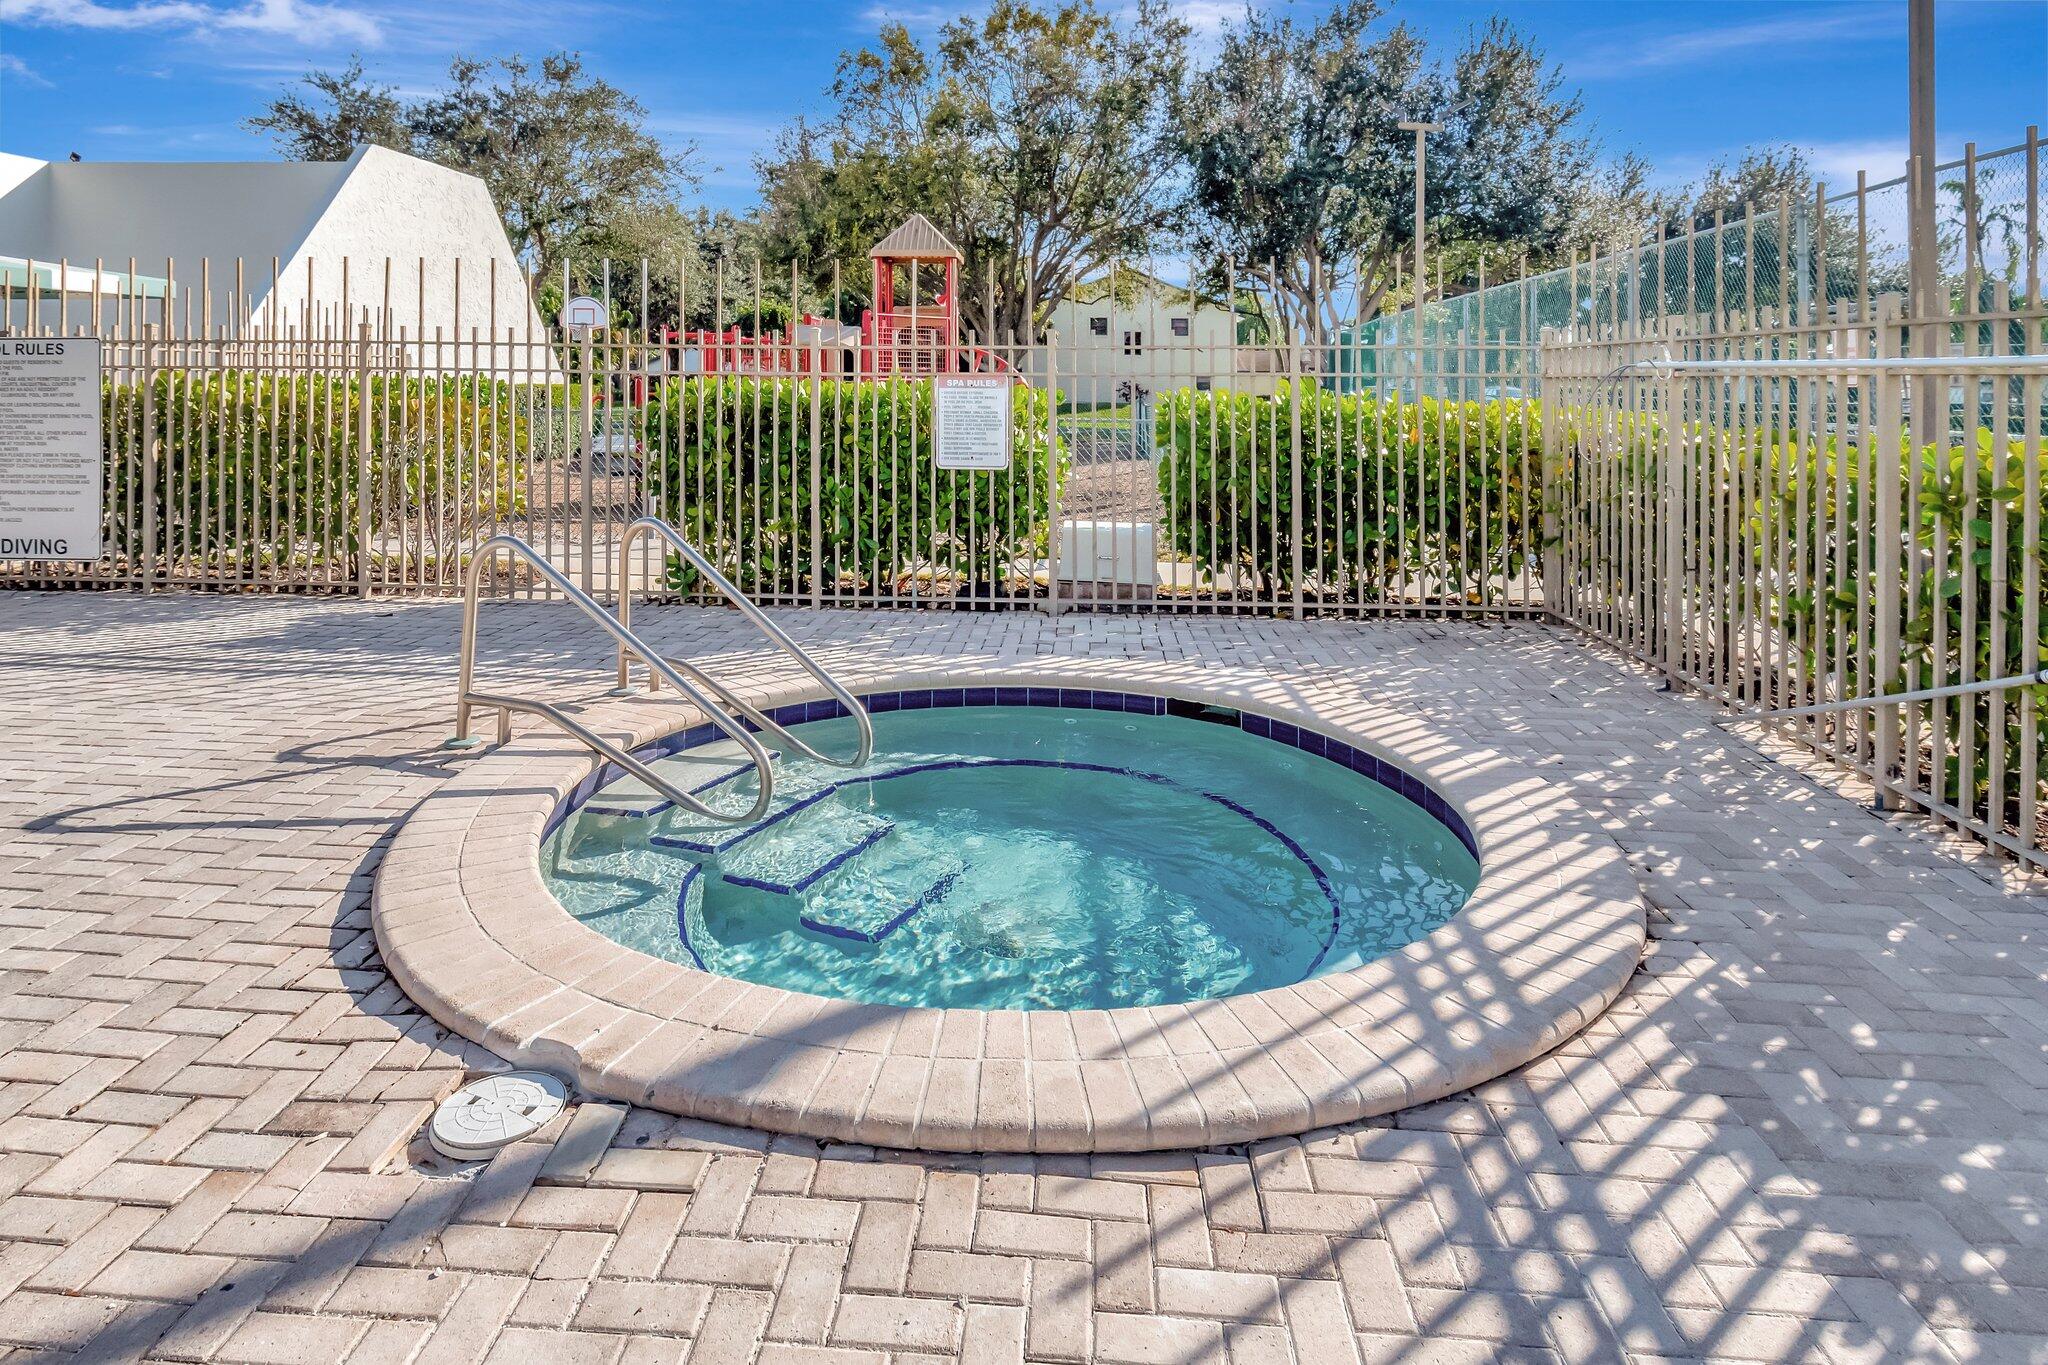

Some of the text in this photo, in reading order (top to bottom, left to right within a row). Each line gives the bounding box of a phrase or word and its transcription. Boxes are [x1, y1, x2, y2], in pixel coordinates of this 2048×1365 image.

[0, 343, 65, 356] L RULES
[946, 379, 998, 387] SPA RULES
[1, 538, 68, 554] DIVING
